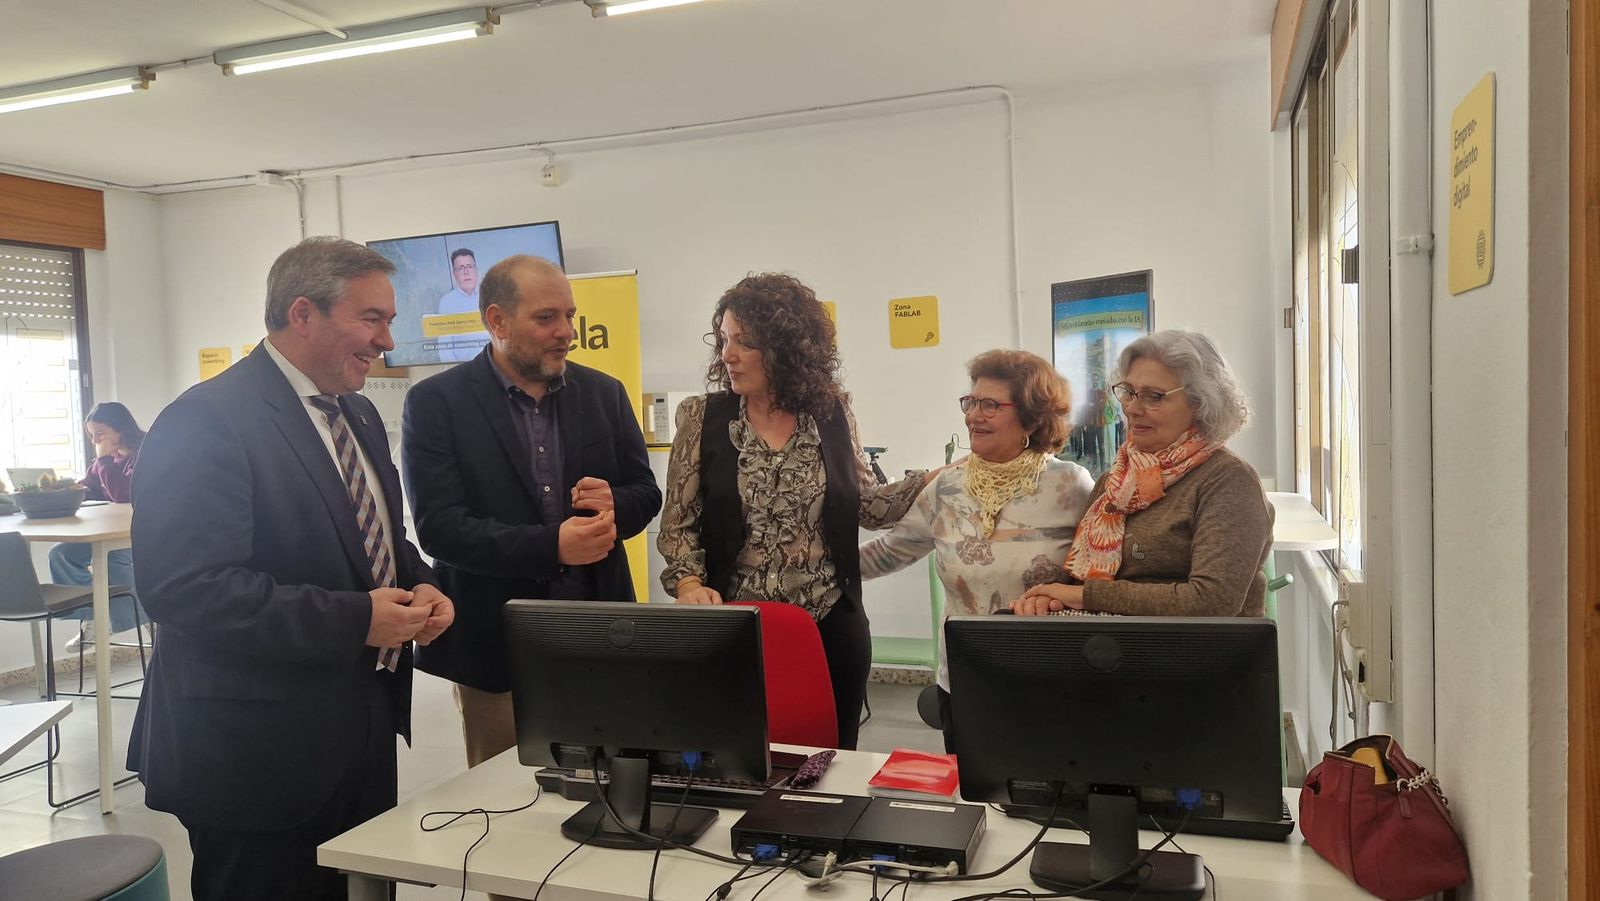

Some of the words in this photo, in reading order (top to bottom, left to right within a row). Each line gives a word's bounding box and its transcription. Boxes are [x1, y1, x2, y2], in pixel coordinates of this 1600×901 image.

[1454, 118, 1477, 150] Empren-
[1454, 145, 1478, 178] dimiento
[1453, 175, 1471, 210] digital
[895, 310, 921, 318] FABLAB
